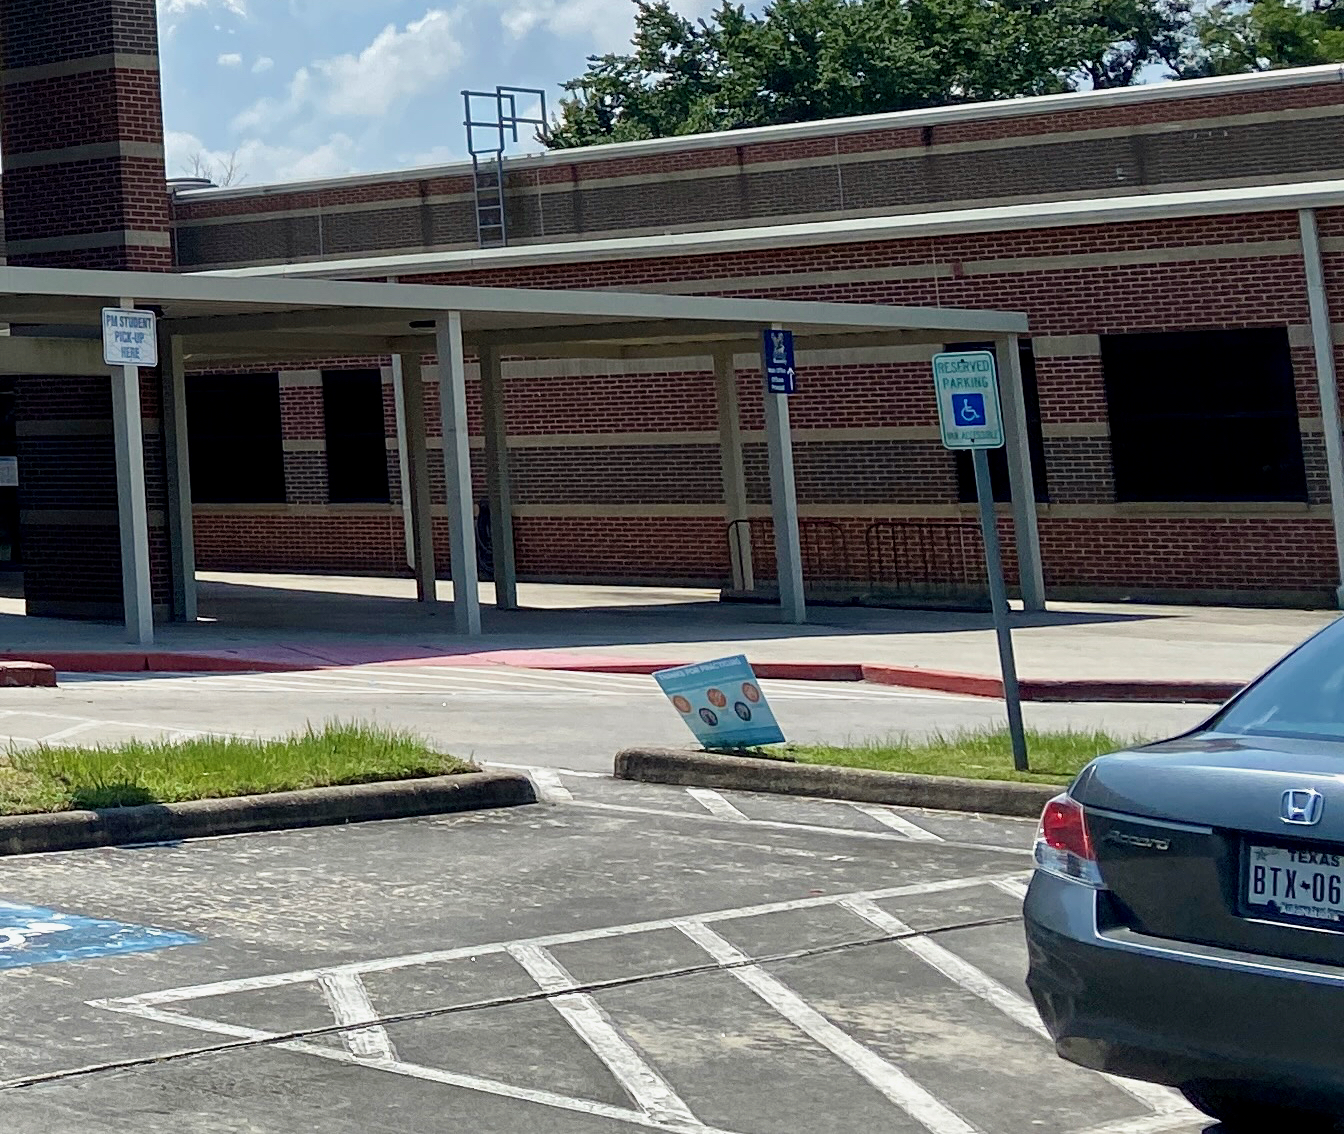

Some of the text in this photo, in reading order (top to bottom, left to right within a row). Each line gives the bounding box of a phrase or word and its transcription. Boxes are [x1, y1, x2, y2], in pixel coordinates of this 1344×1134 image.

[106, 315, 152, 329] PM STUDENT
[121, 346, 140, 359] HERE
[937, 360, 990, 374] RESERVED
[942, 376, 989, 389] PARKING
[1103, 830, 1171, 851] Accord
[1288, 849, 1340, 867] TEXAS
[1254, 865, 1296, 899] BTX
